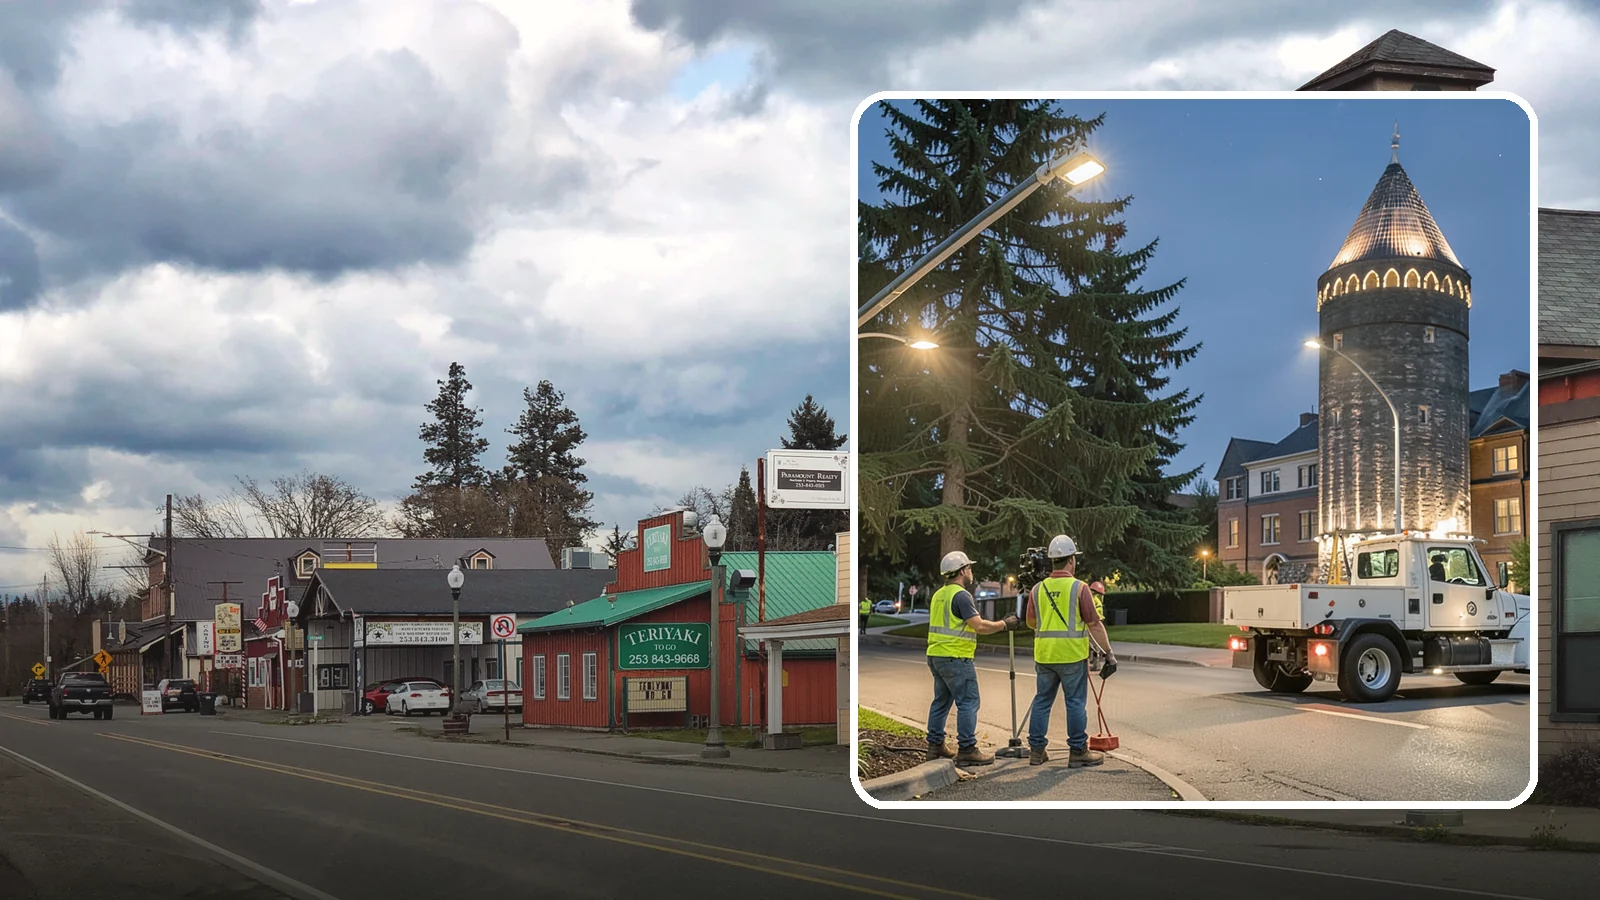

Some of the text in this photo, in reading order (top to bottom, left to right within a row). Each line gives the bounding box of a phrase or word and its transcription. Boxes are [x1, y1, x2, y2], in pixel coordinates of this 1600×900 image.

[624, 627, 702, 646] TERIYAKI
[665, 643, 677, 651] GO
[628, 653, 700, 665] 253 843-9668
